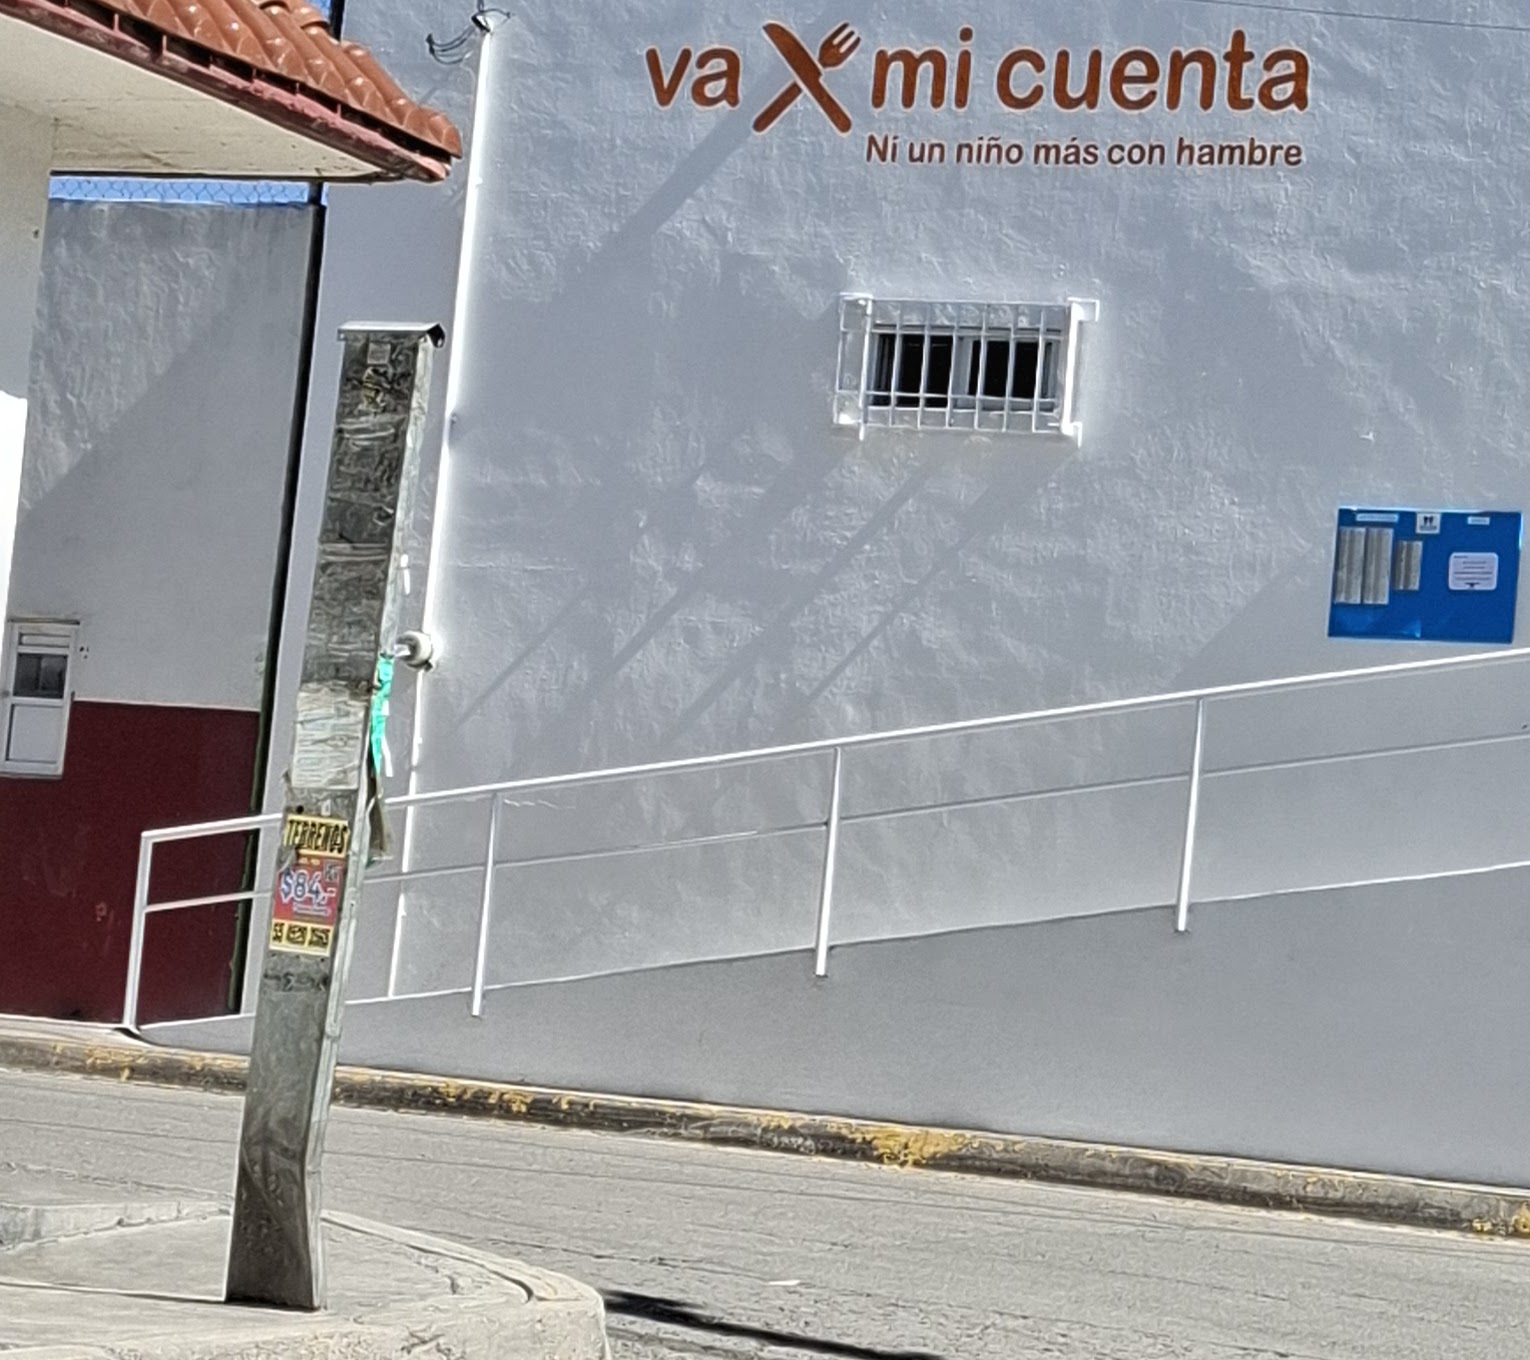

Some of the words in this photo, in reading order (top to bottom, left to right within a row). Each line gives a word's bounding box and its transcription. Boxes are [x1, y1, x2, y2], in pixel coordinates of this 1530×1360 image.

[645, 47, 741, 109] va
[871, 26, 974, 110] mi
[996, 29, 1310, 112] cuenta
[866, 133, 898, 164] Ni
[908, 142, 945, 164] un
[956, 136, 1024, 166] niño
[1033, 136, 1099, 166] más
[1107, 143, 1165, 166] con
[1176, 136, 1302, 167] hambre
